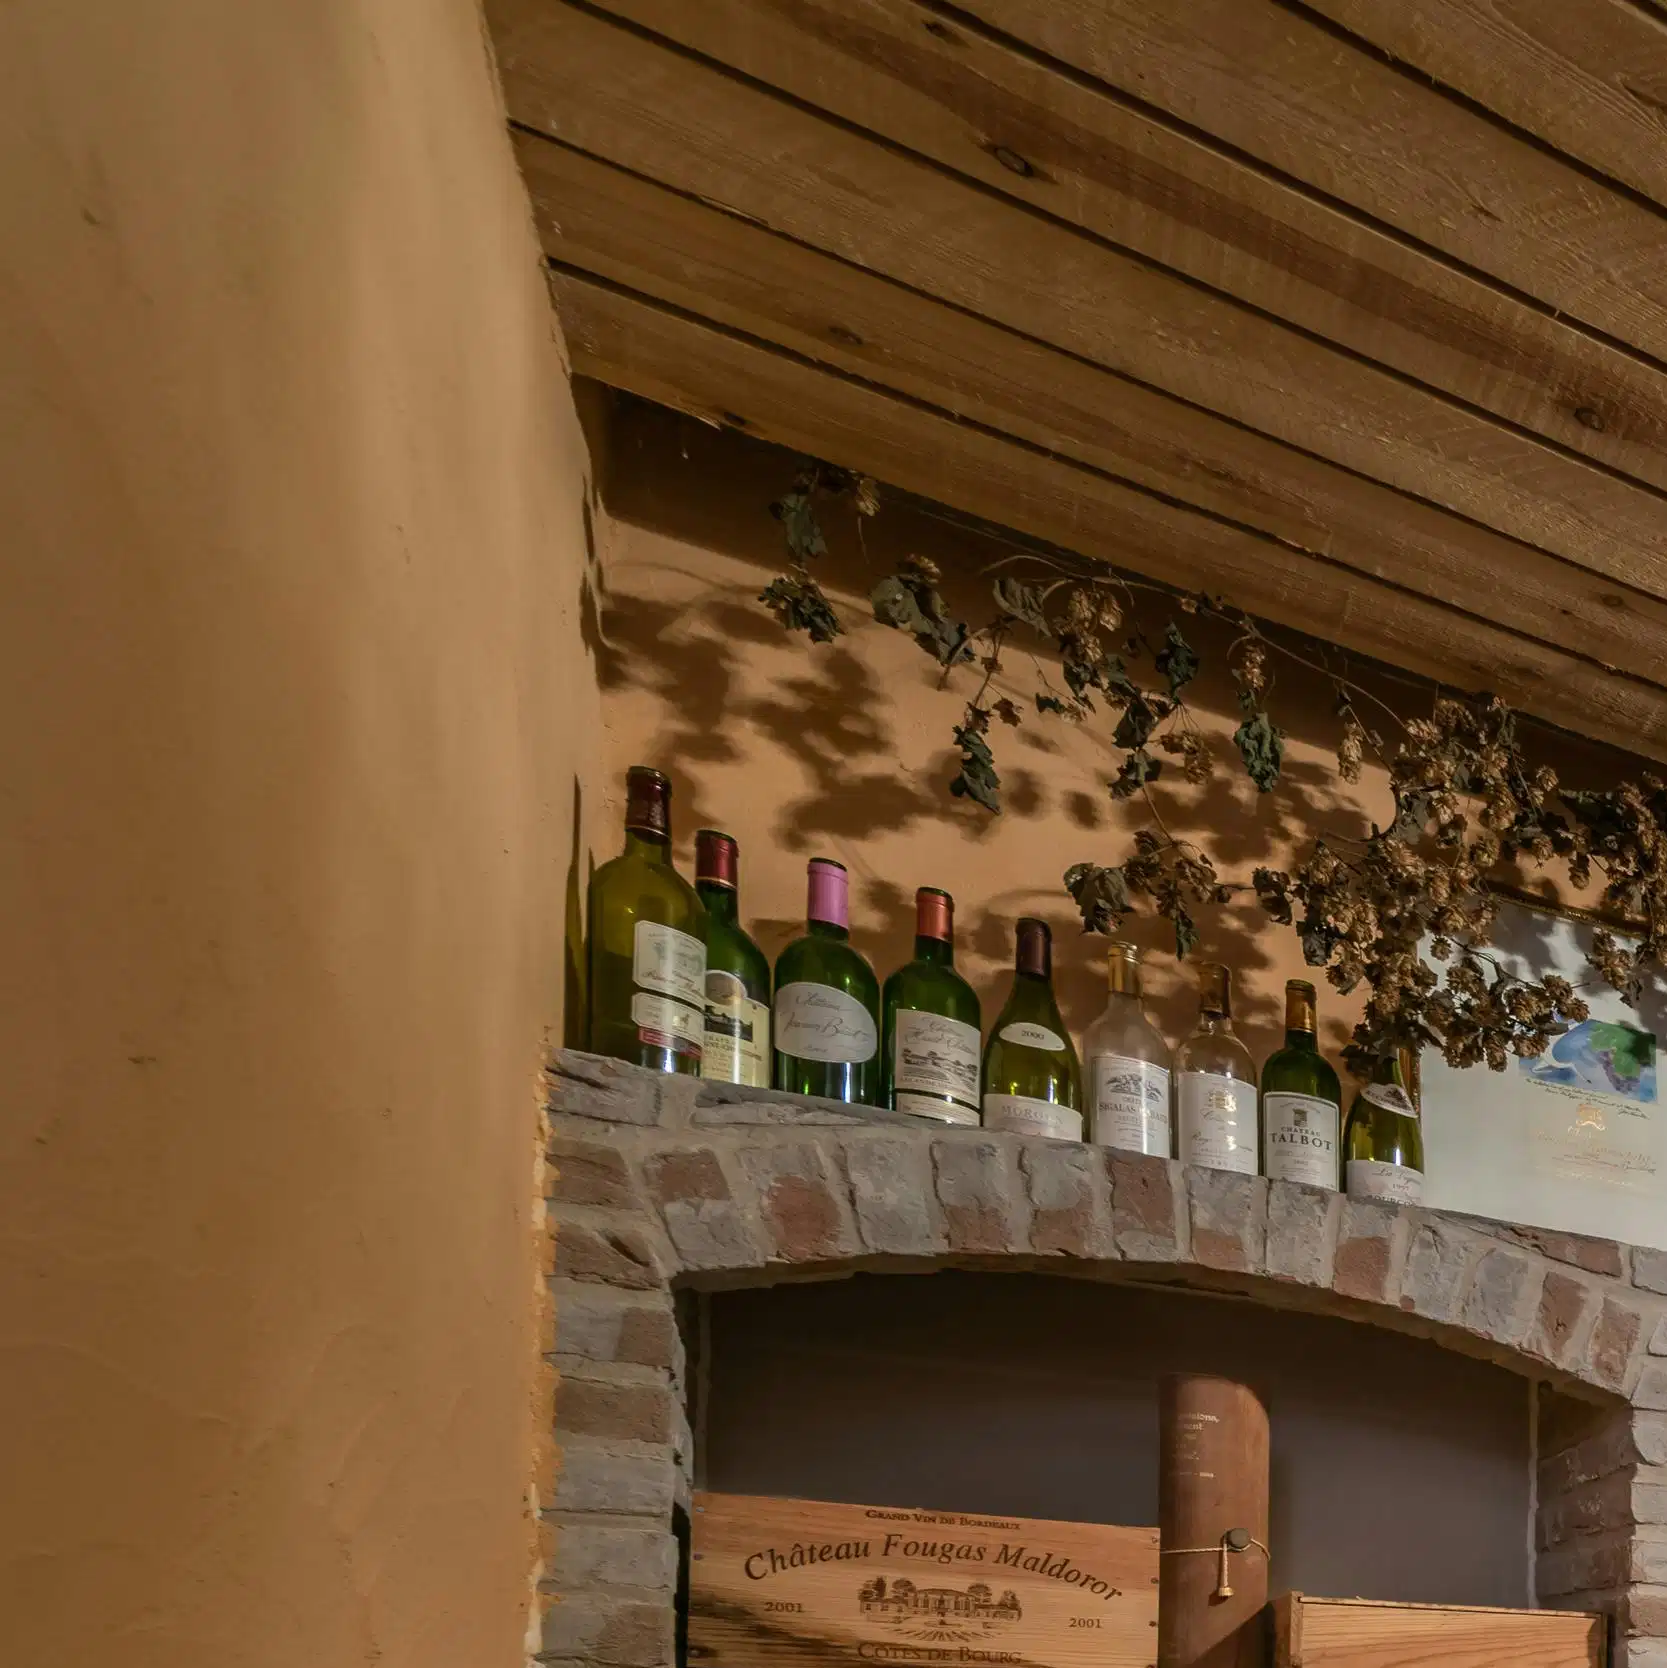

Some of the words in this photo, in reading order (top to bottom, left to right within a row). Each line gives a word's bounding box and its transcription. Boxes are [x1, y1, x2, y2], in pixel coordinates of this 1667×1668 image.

[1270, 1131, 1332, 1152] TALBOT
[865, 1509, 910, 1524] GRAND
[911, 1513, 938, 1525] VIN
[939, 1515, 956, 1526] DE
[957, 1517, 1021, 1531] BORDEAUX
[744, 1535, 871, 1581] Château
[882, 1532, 987, 1566] Fougas
[995, 1543, 1123, 1602] Maldoror
[764, 1600, 805, 1614] 2001
[1068, 1617, 1103, 1630] 2001
[927, 1647, 952, 1662] DE
[958, 1646, 1023, 1666] BOURG
